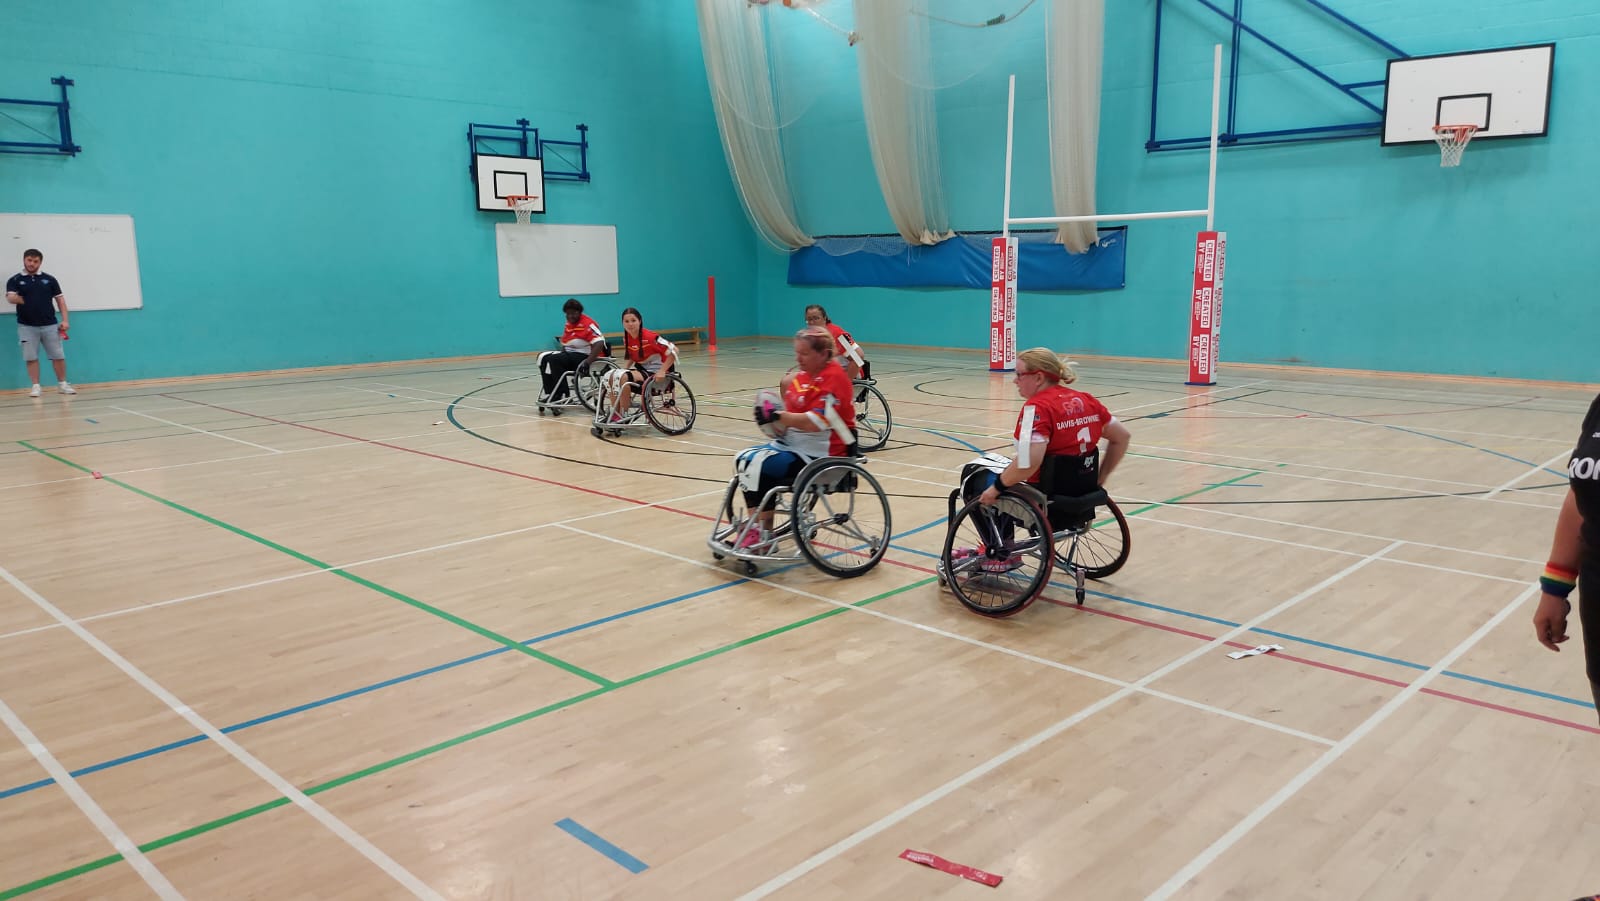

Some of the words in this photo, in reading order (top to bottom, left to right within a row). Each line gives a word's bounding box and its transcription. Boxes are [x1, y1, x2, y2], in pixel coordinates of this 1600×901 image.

[1198, 242, 1205, 253] BY
[1204, 242, 1213, 279] CREATED
[1195, 289, 1202, 300] BY
[1202, 290, 1210, 326] CREATED
[1192, 336, 1200, 348] BY
[1200, 336, 1208, 373] CREATED
[1056, 415, 1099, 430] DAVIS-BROWNE
[1077, 427, 1091, 453] 1
